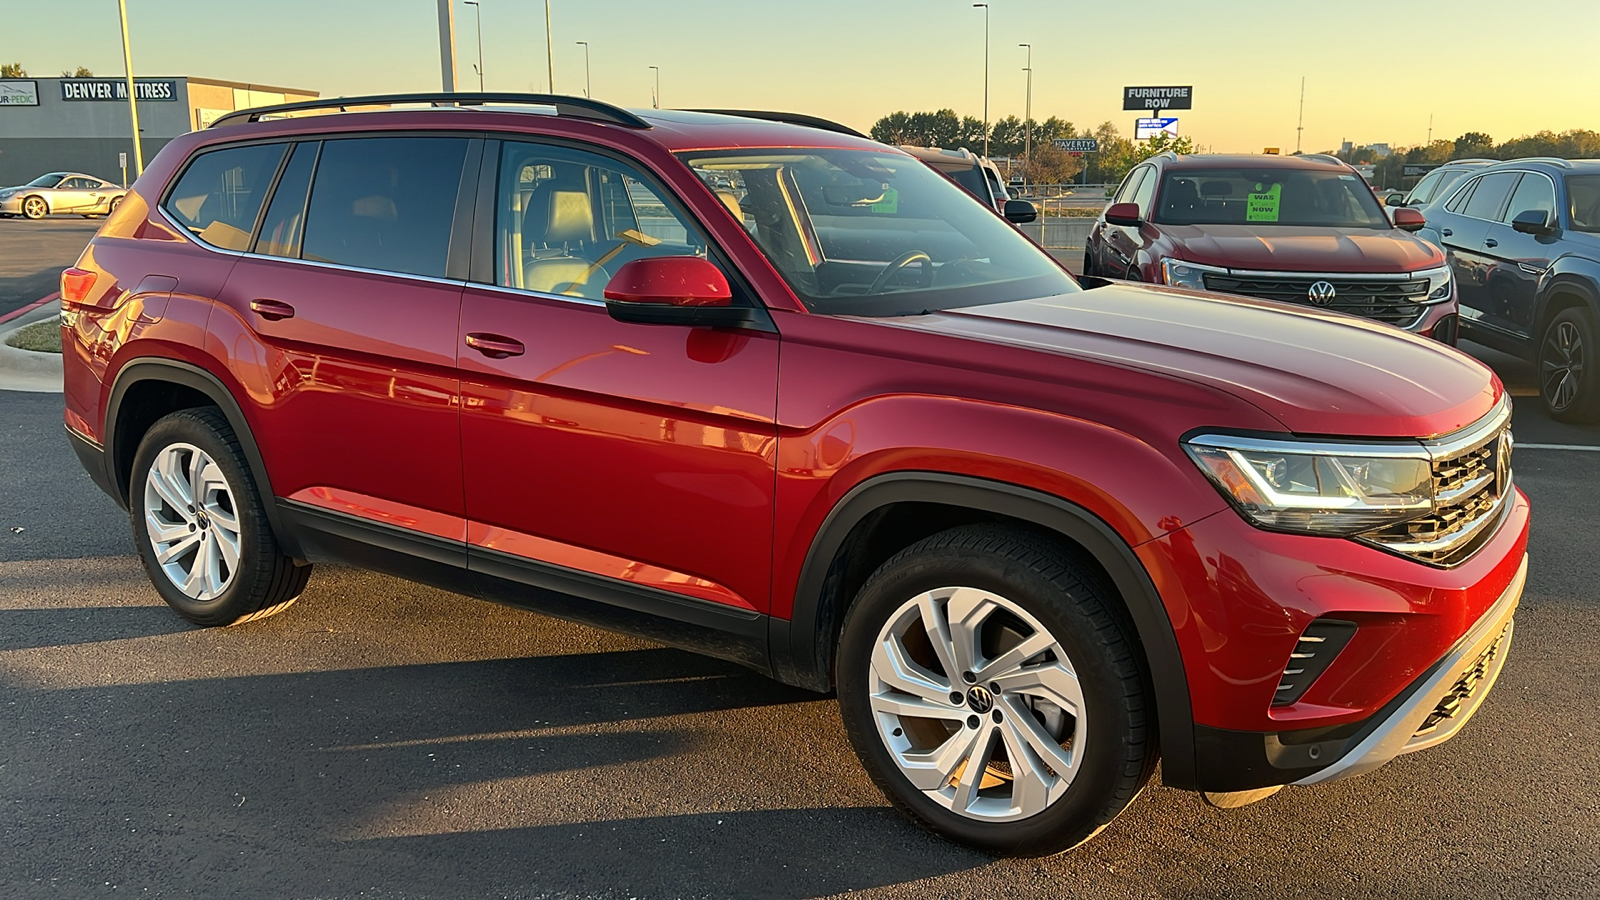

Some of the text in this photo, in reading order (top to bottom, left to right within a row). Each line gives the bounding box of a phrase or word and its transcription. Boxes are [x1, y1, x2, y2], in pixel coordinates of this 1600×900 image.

[64, 83, 171, 98] DENVER MTTRESS
[1128, 88, 1188, 98] FURNITURE
[1145, 98, 1170, 108] ROW
